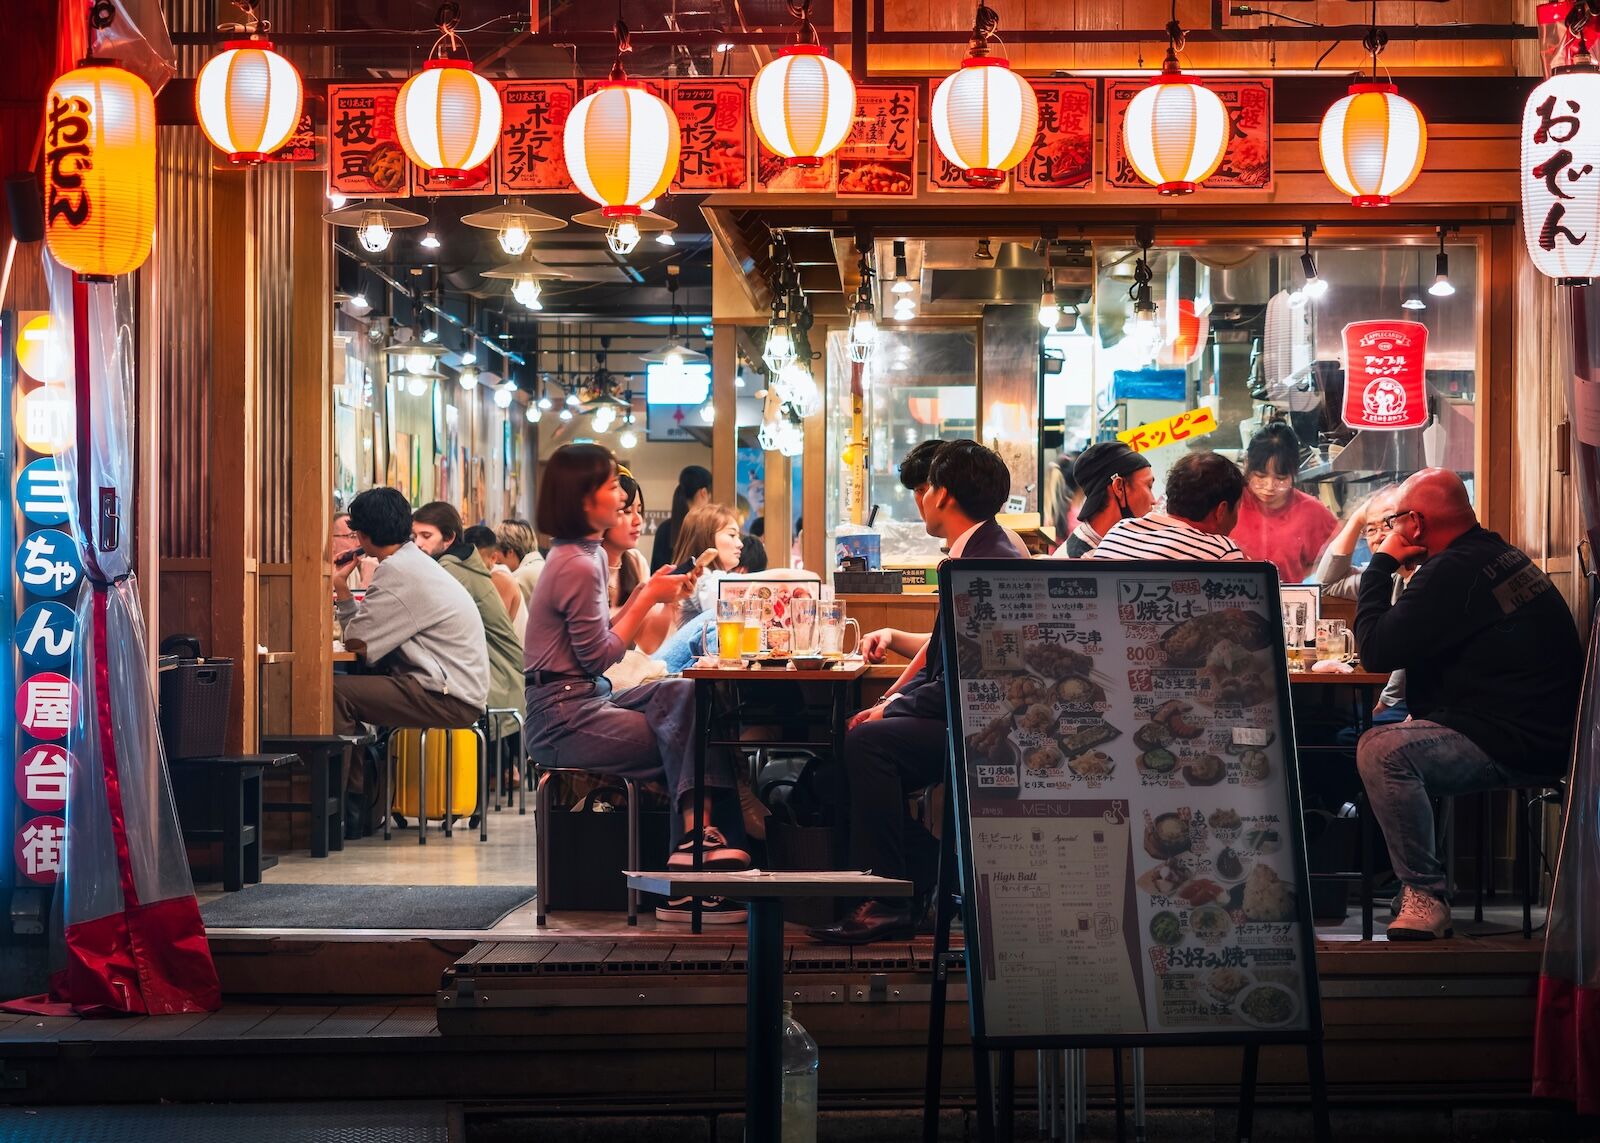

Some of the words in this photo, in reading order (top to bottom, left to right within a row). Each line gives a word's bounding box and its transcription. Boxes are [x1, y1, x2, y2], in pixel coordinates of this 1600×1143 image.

[338, 99, 374, 108] とりあえず
[508, 92, 545, 102] とりあえず
[888, 92, 911, 151] おでん
[334, 111, 376, 180] 枝豆
[525, 103, 553, 173] ポテト
[694, 103, 717, 175] フライド
[48, 94, 92, 227] おでん
[504, 123, 531, 183] サラダ
[680, 123, 704, 183] ポテト
[1532, 95, 1593, 250] おでん
[1365, 355, 1406, 365] アップル
[1365, 365, 1408, 375] キャンデー
[1128, 413, 1209, 453] ホッピー
[1122, 583, 1174, 603] ソース
[967, 577, 998, 639] 串焼き
[1136, 600, 1195, 621] 焼そば
[1039, 628, 1102, 645] 牛ハラミ串
[1022, 803, 1071, 816] MENU
[977, 832, 1023, 843] 生ビール
[993, 871, 1016, 883] High
[1017, 871, 1038, 881] Ball
[1235, 922, 1292, 935] ポテトサラダ
[1166, 945, 1248, 968] お好み焼
